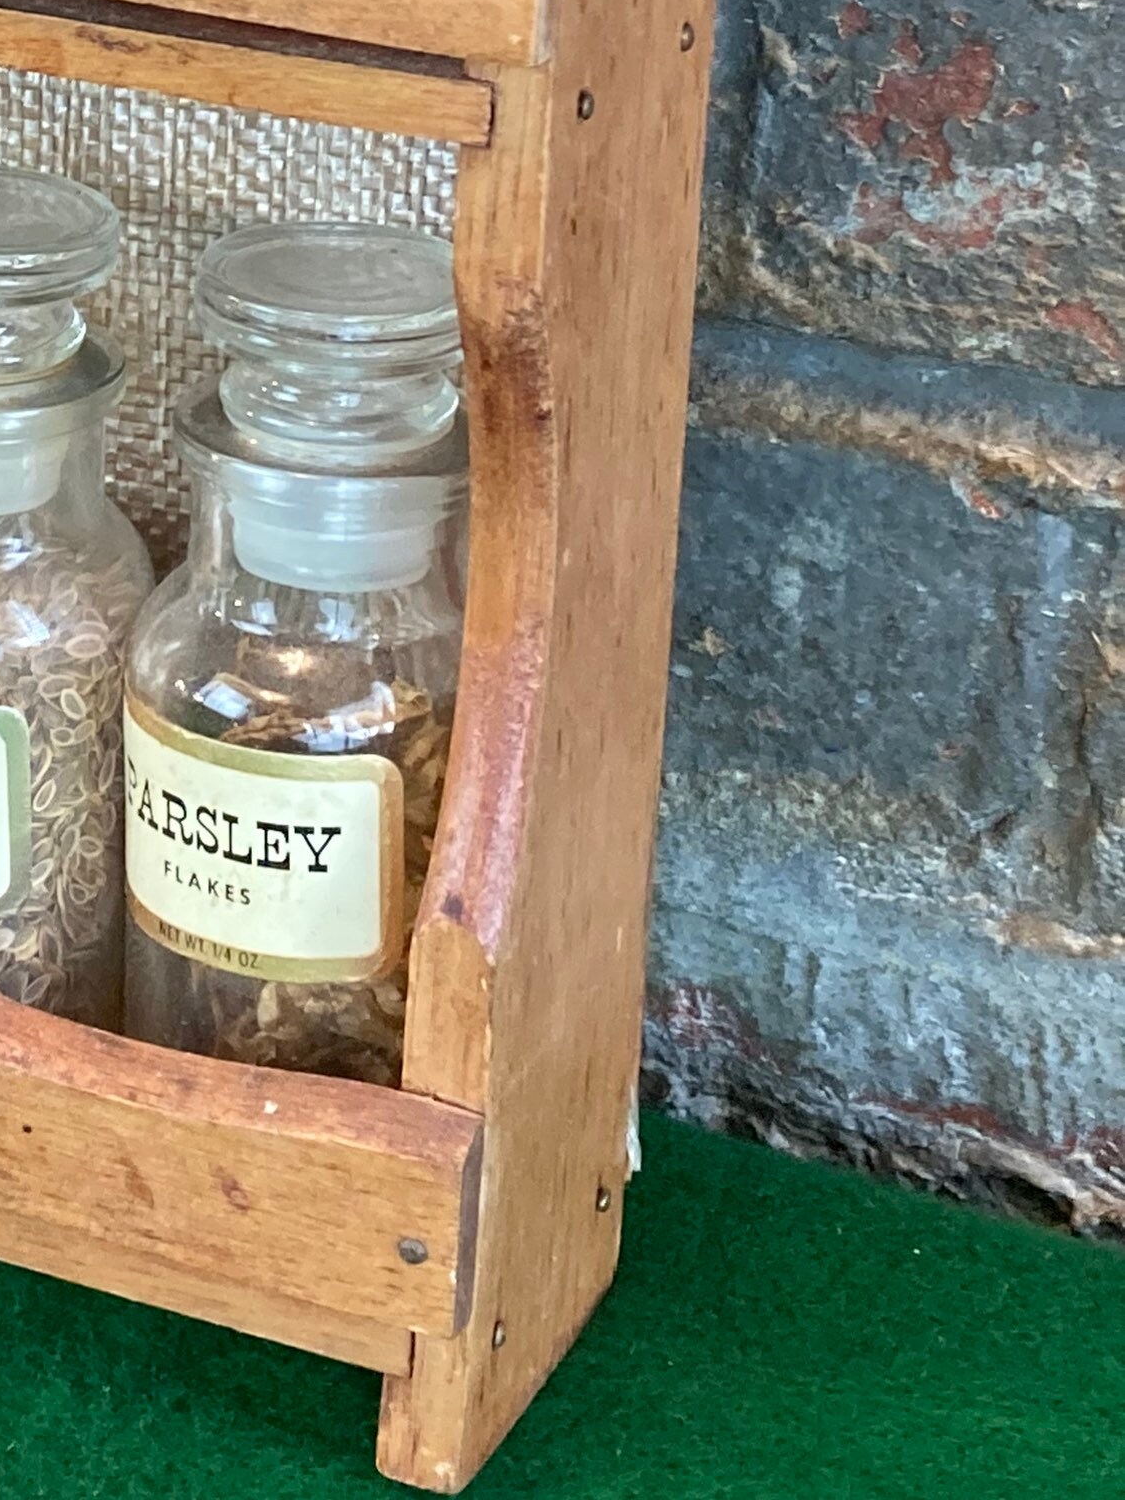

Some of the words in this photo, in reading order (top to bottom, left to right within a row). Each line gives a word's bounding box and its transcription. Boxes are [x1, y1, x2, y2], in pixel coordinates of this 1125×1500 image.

[163, 859, 252, 906] FLAKES
[158, 920, 180, 944] NET
[212, 942, 231, 963] 1/4
[238, 950, 259, 969] OZ
